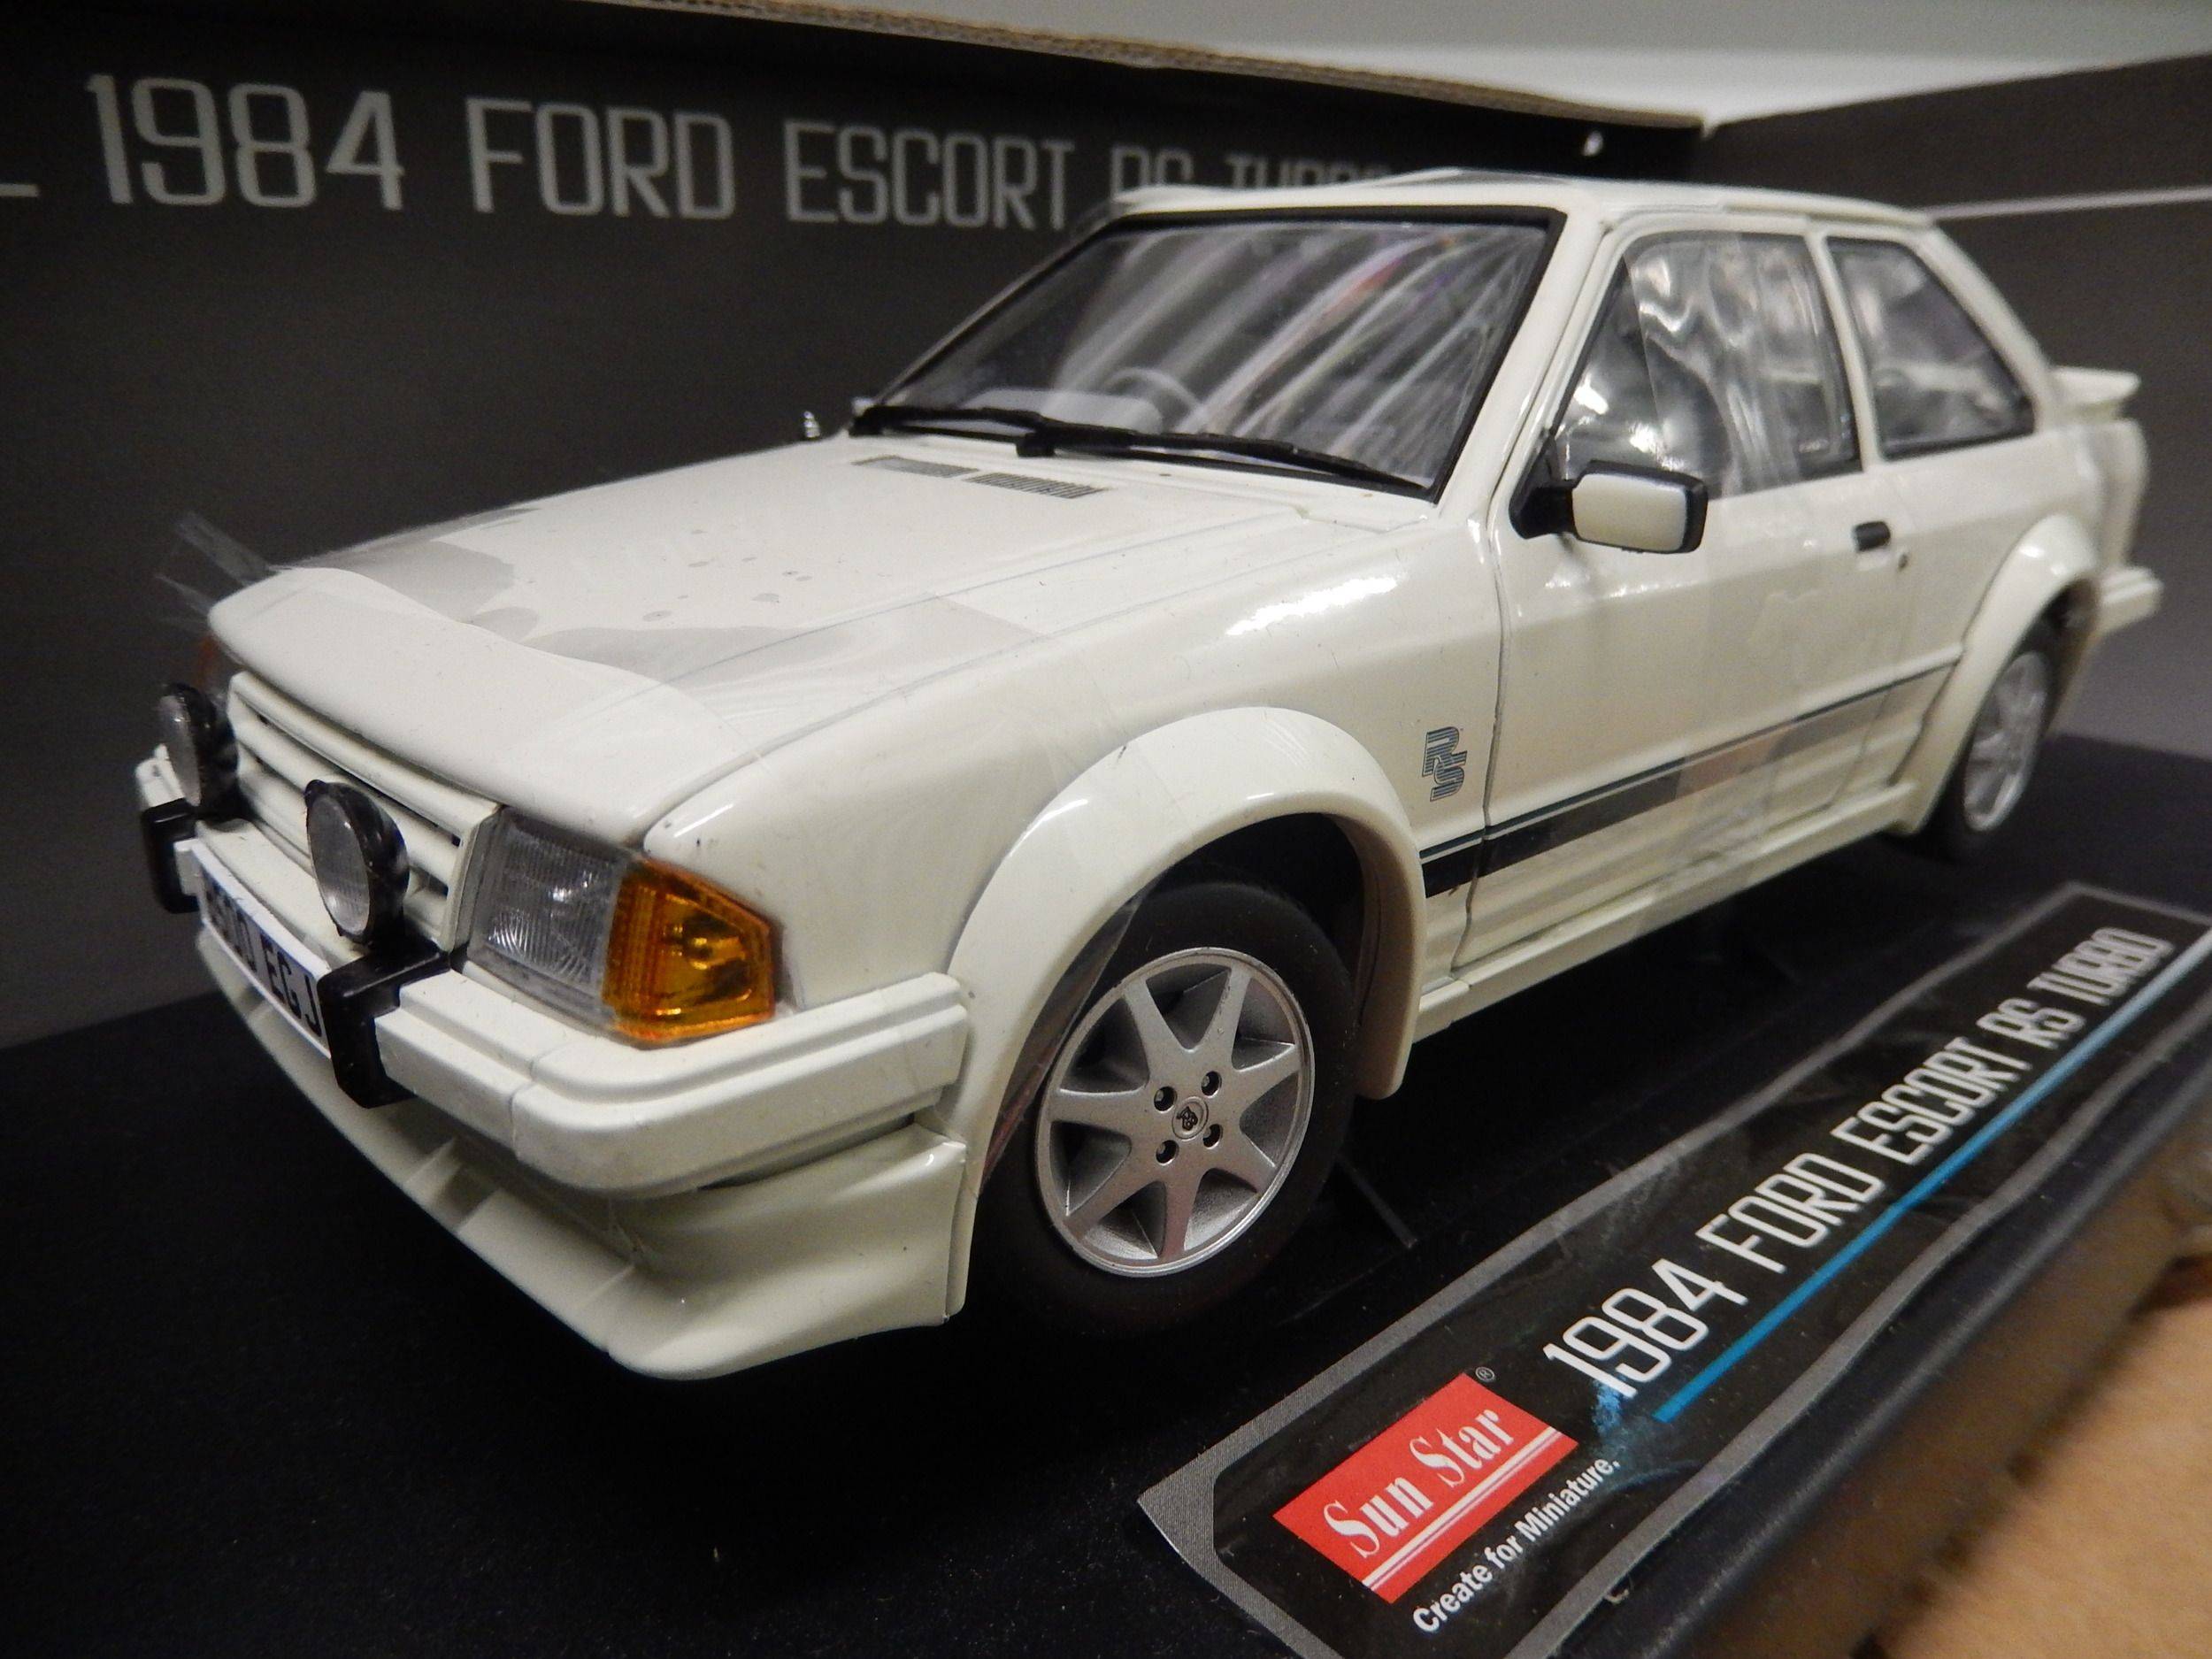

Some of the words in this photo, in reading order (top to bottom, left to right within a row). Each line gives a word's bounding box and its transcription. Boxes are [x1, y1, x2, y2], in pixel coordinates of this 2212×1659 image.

[84, 74, 404, 211] 1984
[465, 96, 736, 220] FORD
[782, 119, 1075, 231] ESCORT
[1422, 726, 1467, 802] RS
[1976, 997, 2086, 1050] RS
[2026, 926, 2177, 1007] TURBO
[1831, 1036, 2032, 1165] ESCORT
[1695, 1152, 1886, 1274] FORD
[1543, 1258, 1748, 1399] 1984
[1323, 1473, 1433, 1558] Sun
[1409, 1408, 1514, 1487] Star
[1413, 1563, 1493, 1634] Create
[1486, 1534, 1524, 1566] for
[1520, 1458, 1620, 1542] Miniature.
